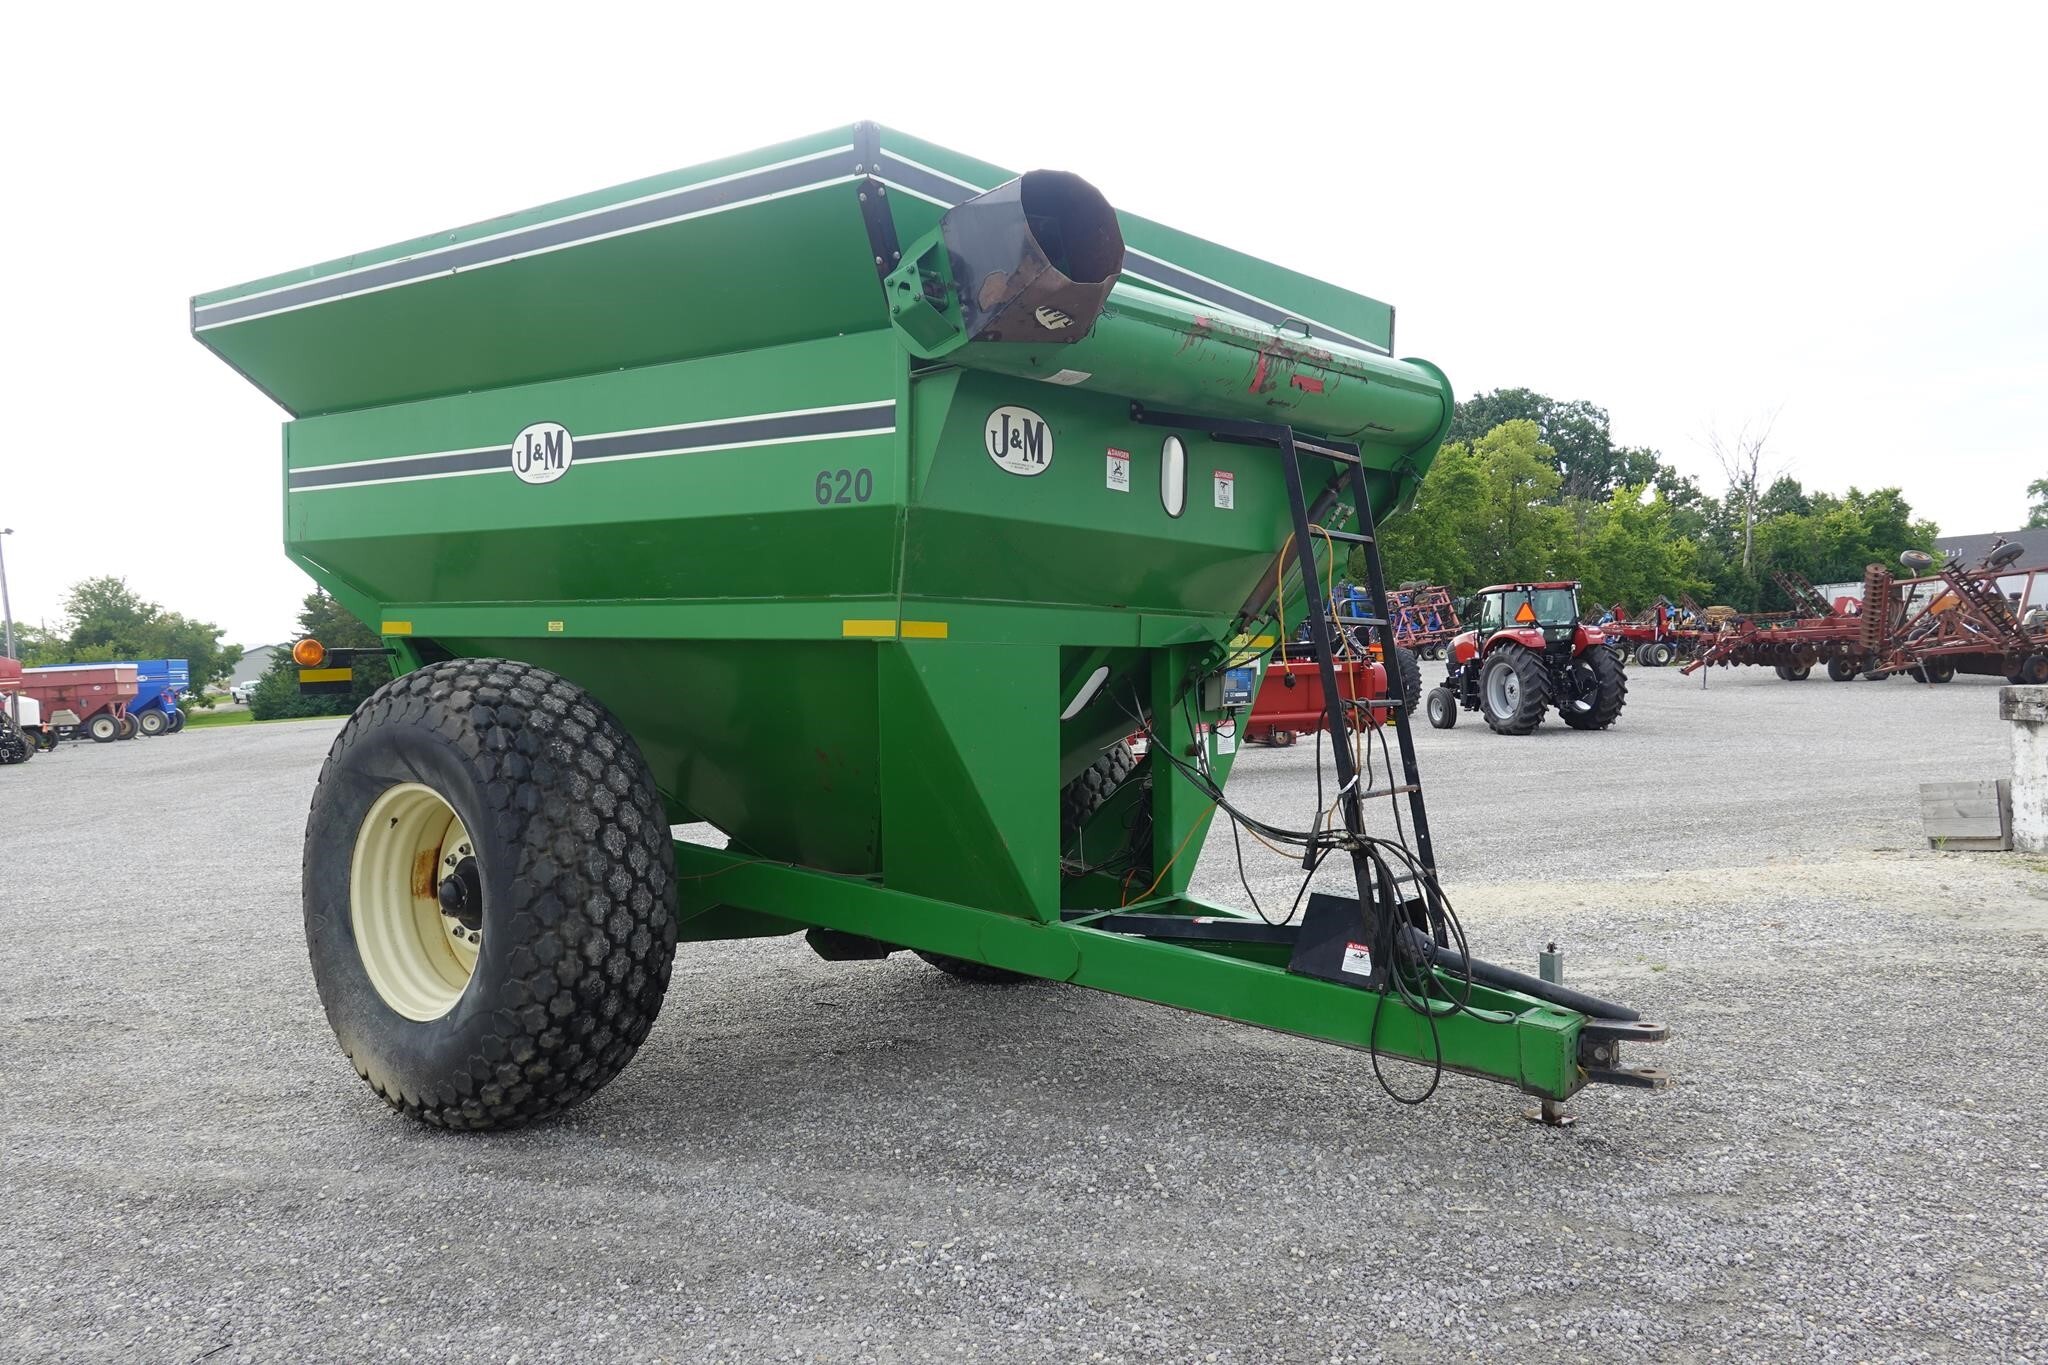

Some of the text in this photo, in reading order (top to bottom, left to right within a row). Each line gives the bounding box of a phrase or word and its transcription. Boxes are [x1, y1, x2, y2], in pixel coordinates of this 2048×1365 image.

[516, 429, 565, 473] J&M
[991, 414, 1044, 465] J&M
[815, 468, 873, 505] 620
